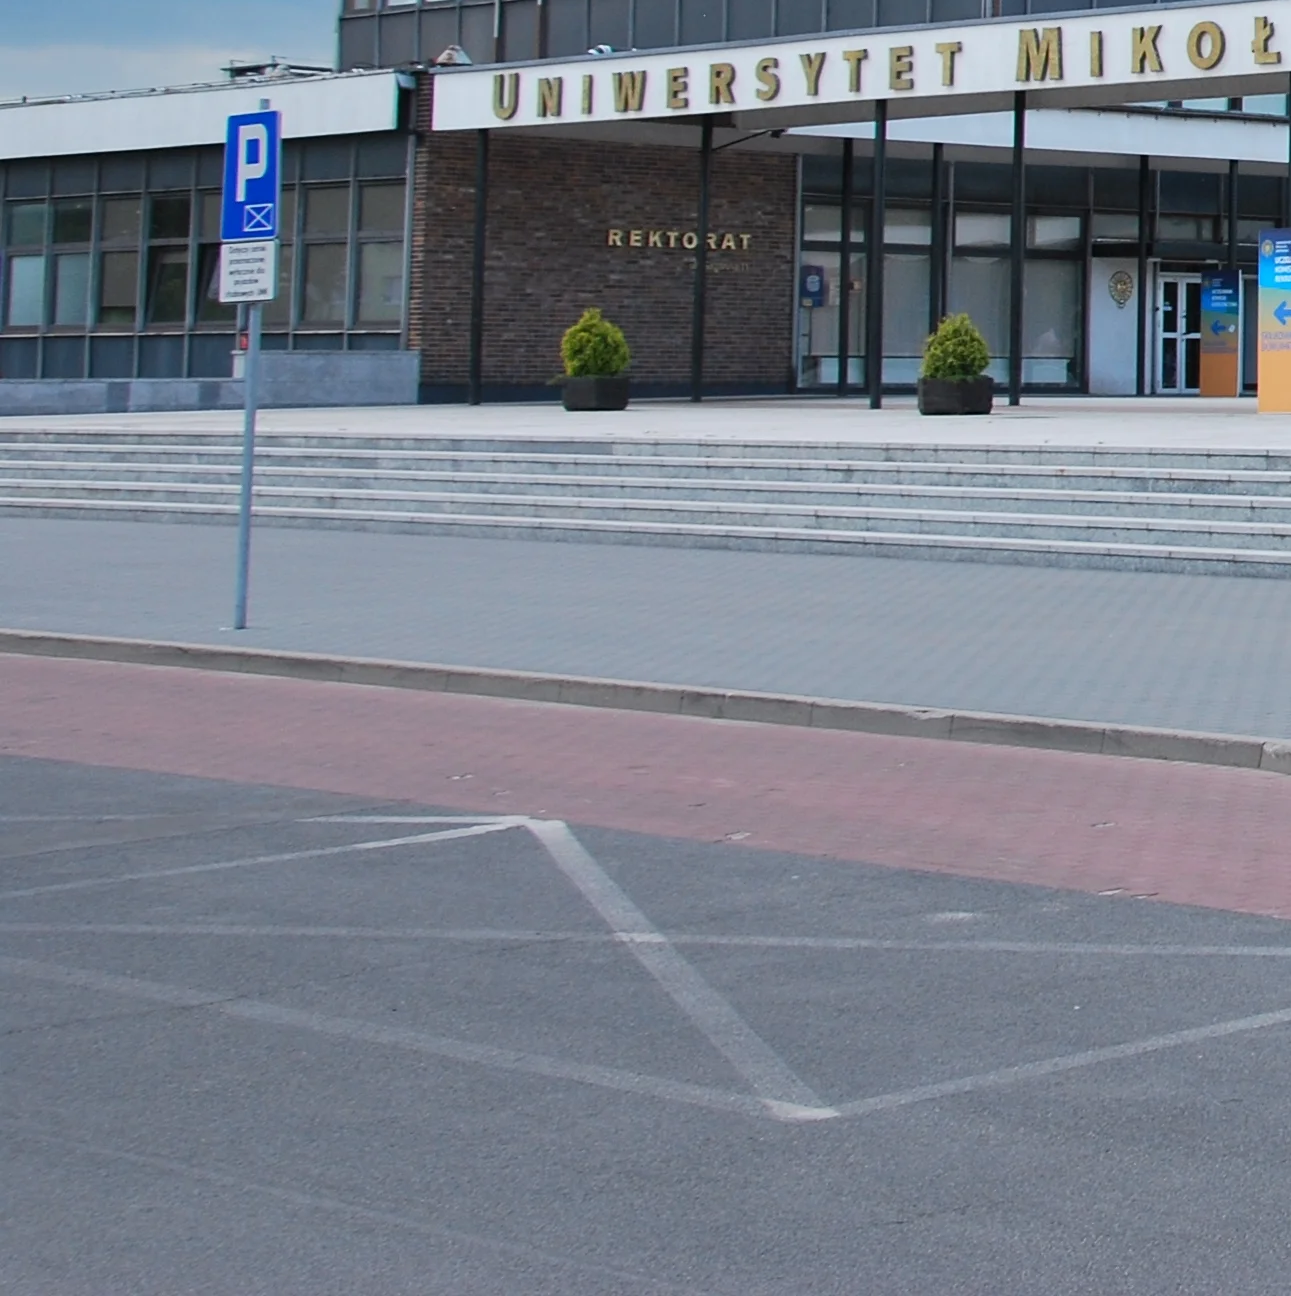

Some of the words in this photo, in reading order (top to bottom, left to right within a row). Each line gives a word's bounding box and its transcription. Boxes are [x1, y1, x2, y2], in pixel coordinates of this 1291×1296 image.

[493, 41, 962, 120] UNIWERSYTET
[235, 123, 268, 202] P
[607, 229, 751, 250] REKTORAT
